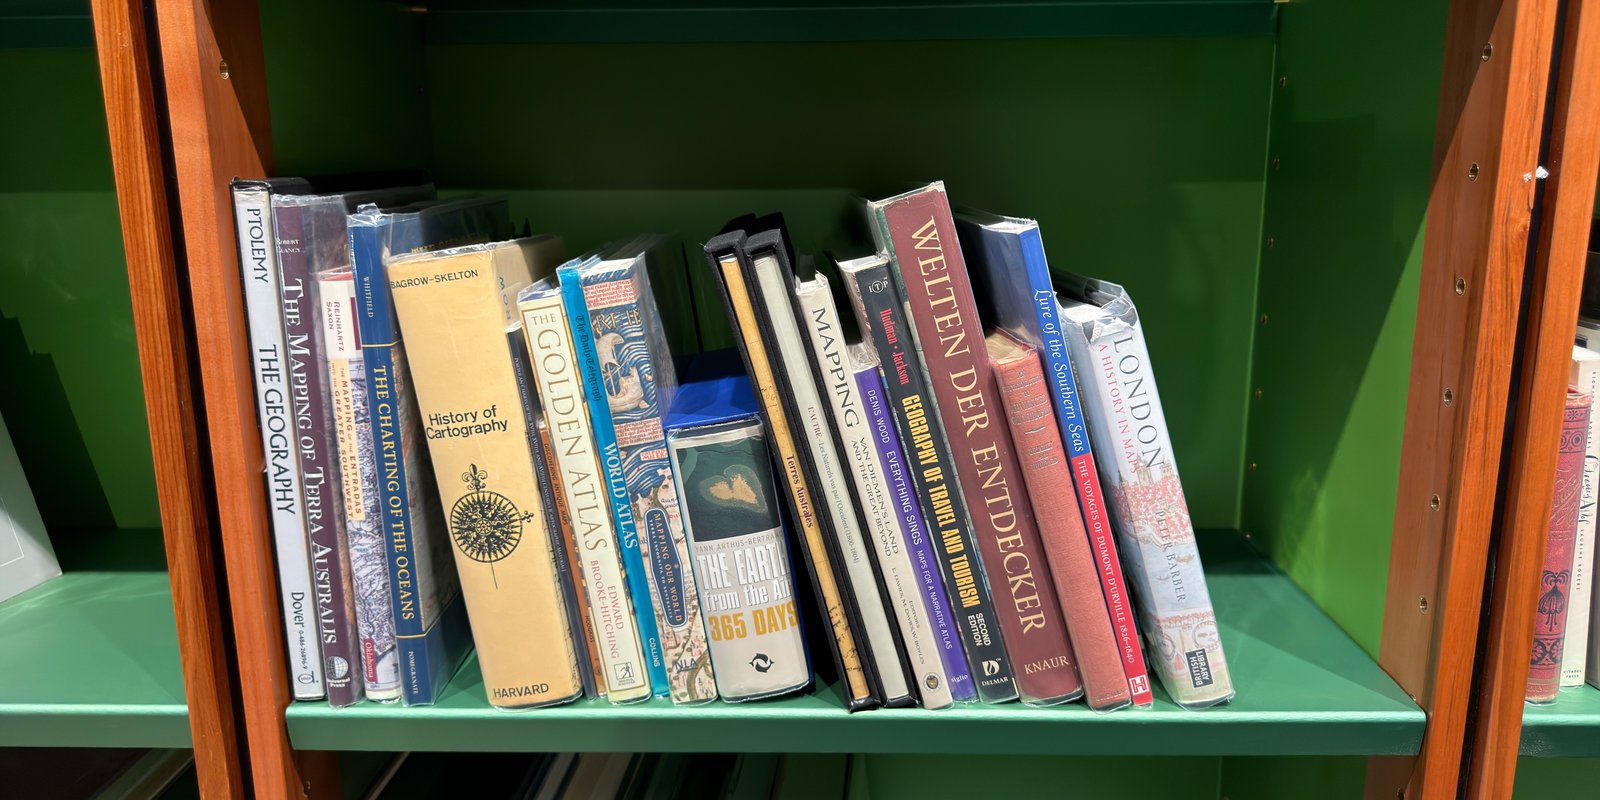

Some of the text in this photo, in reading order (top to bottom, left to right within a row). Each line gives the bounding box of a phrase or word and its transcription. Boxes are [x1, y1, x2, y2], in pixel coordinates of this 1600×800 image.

[247, 208, 268, 283] PTOLEMY
[363, 276, 373, 318] WHITFIELD
[391, 269, 478, 289] BAGROW-SKELTON
[333, 301, 345, 352] REINHARTZ
[531, 314, 557, 326] THE
[880, 308, 910, 385] Hudman Jackson
[812, 307, 860, 428] MAPPING
[1034, 290, 1084, 453] Lure of the Southern Seas
[428, 405, 497, 426] History of
[807, 406, 823, 439] L'AUTRE
[1099, 344, 1138, 474] A HISTORY IN MAPS
[1113, 336, 1164, 468] LONDON
[259, 344, 295, 515] THE GEOGRAPHY
[426, 419, 508, 440] Cartography
[538, 329, 607, 551] GOLDEN ATLAS
[911, 215, 971, 358] WELTEN
[950, 364, 990, 438] DER
[971, 441, 1046, 635] ENTDECKER
[283, 278, 337, 644] THE MAPPING OF TERRA AUSTRALIS
[335, 391, 345, 444] GREATER
[341, 449, 354, 519] SOUTHWEST
[342, 380, 353, 431] MAPPING
[351, 455, 361, 514] ENTRADAS
[817, 441, 827, 454] Les
[820, 453, 834, 479] Naturels
[828, 478, 836, 489] vus
[1078, 459, 1089, 478] THE
[373, 365, 415, 620] THE CHARTING OF THE OCEANS
[604, 442, 637, 549] WORLD ATLAS
[786, 455, 814, 529] Terres Australes
[830, 488, 840, 501] par
[850, 439, 891, 557] AND THE GREAT BEYOND
[858, 436, 899, 554] VAN DIEMEN'S LAND
[902, 394, 981, 608] GEOGRAPHY OF TRAVEL AND TOURISM
[1083, 480, 1100, 521] VOYAGES
[834, 499, 850, 529] l'Occident
[867, 389, 882, 416] DENIS
[877, 417, 890, 444] WOOD
[886, 450, 913, 513] EVERYTHING
[906, 514, 923, 545] SINGS
[915, 549, 928, 569] MAPS
[922, 570, 932, 584] FOR
[928, 591, 946, 628] NARRATIVE
[940, 628, 953, 650] ATLAS
[1093, 521, 1102, 536] OF
[653, 513, 670, 560] MAPPING
[669, 586, 683, 622] WORLD
[695, 544, 714, 553] YANN
[1096, 535, 1114, 577] DUMONT
[1155, 510, 1187, 602] PETER BARBER
[696, 552, 732, 590] THE
[292, 592, 305, 627] Dover
[590, 560, 620, 659] BROOKE-HITCHING
[607, 585, 624, 630] EDWARD
[704, 590, 741, 612] from
[743, 585, 768, 606] the
[908, 599, 921, 628] EDITORS
[1107, 581, 1126, 625] D'URVILLE
[708, 600, 798, 642] 365 DAYS
[967, 615, 983, 646] EDITION
[976, 612, 991, 646] SECOND
[365, 642, 373, 678] Oklahoma
[649, 637, 661, 668] COLLINS
[1023, 655, 1070, 675] KNAUR
[1189, 656, 1202, 686] BRITISH
[1195, 651, 1210, 680] LIBRARY
[493, 683, 549, 699] HARVARD
[951, 674, 969, 683] siglio
[981, 677, 1008, 687] DELMAR
